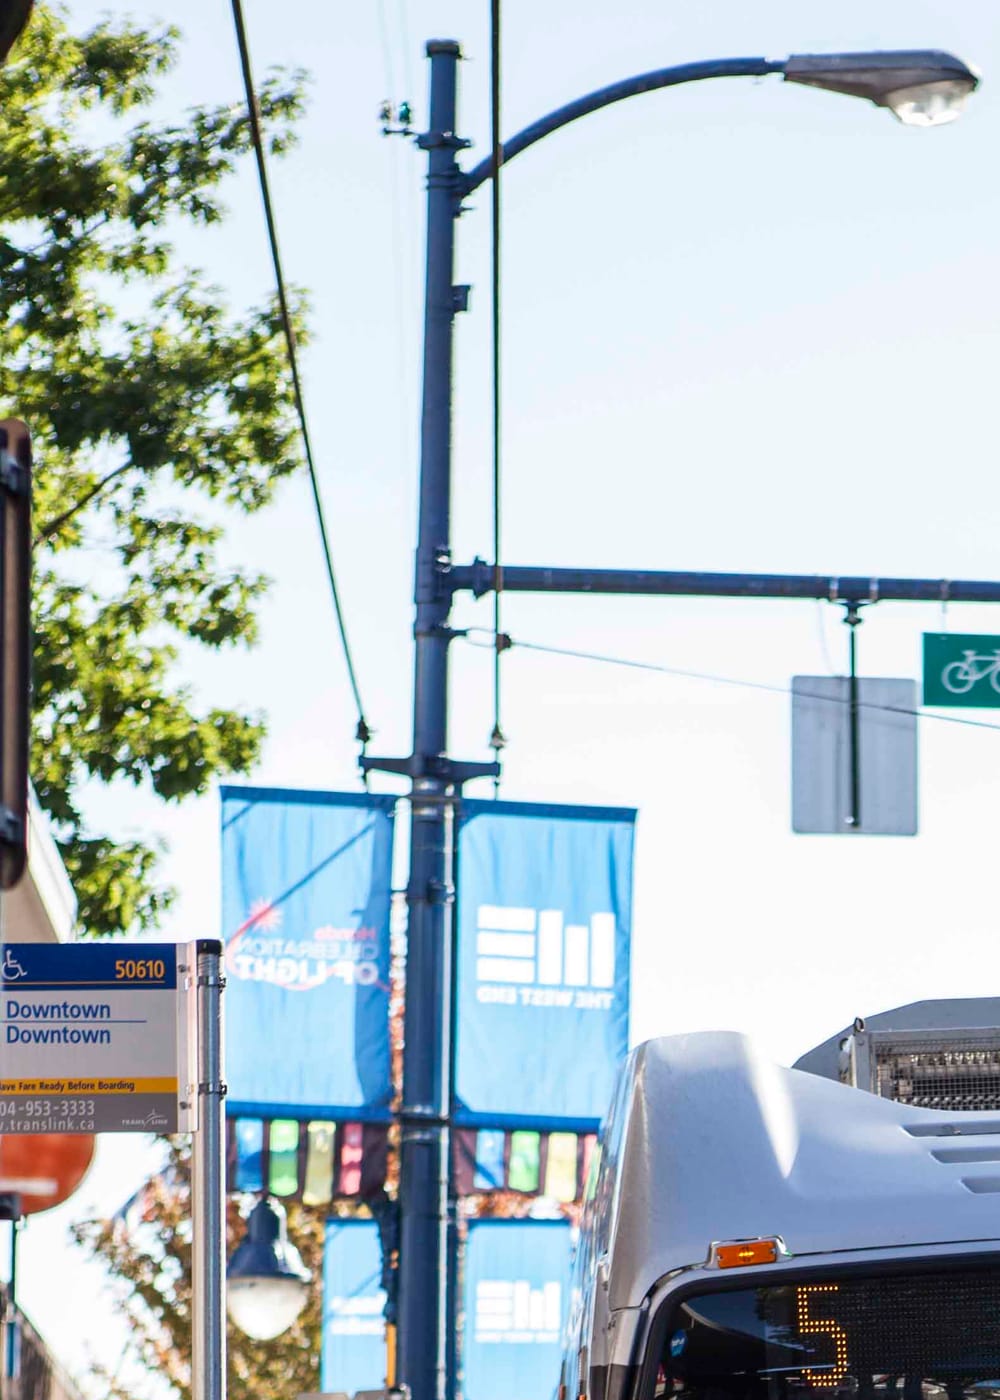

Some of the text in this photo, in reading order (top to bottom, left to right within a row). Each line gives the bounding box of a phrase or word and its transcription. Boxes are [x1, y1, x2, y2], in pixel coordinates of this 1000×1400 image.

[115, 960, 165, 979] 50610
[6, 1000, 111, 1019] Downtown
[6, 1025, 111, 1044] Downtown
[19, 1082, 36, 1091] Fare
[39, 1082, 65, 1092] Ready
[68, 1081, 95, 1090] Before
[98, 1081, 135, 1092] Boarding
[797, 1285, 848, 1387] 5
